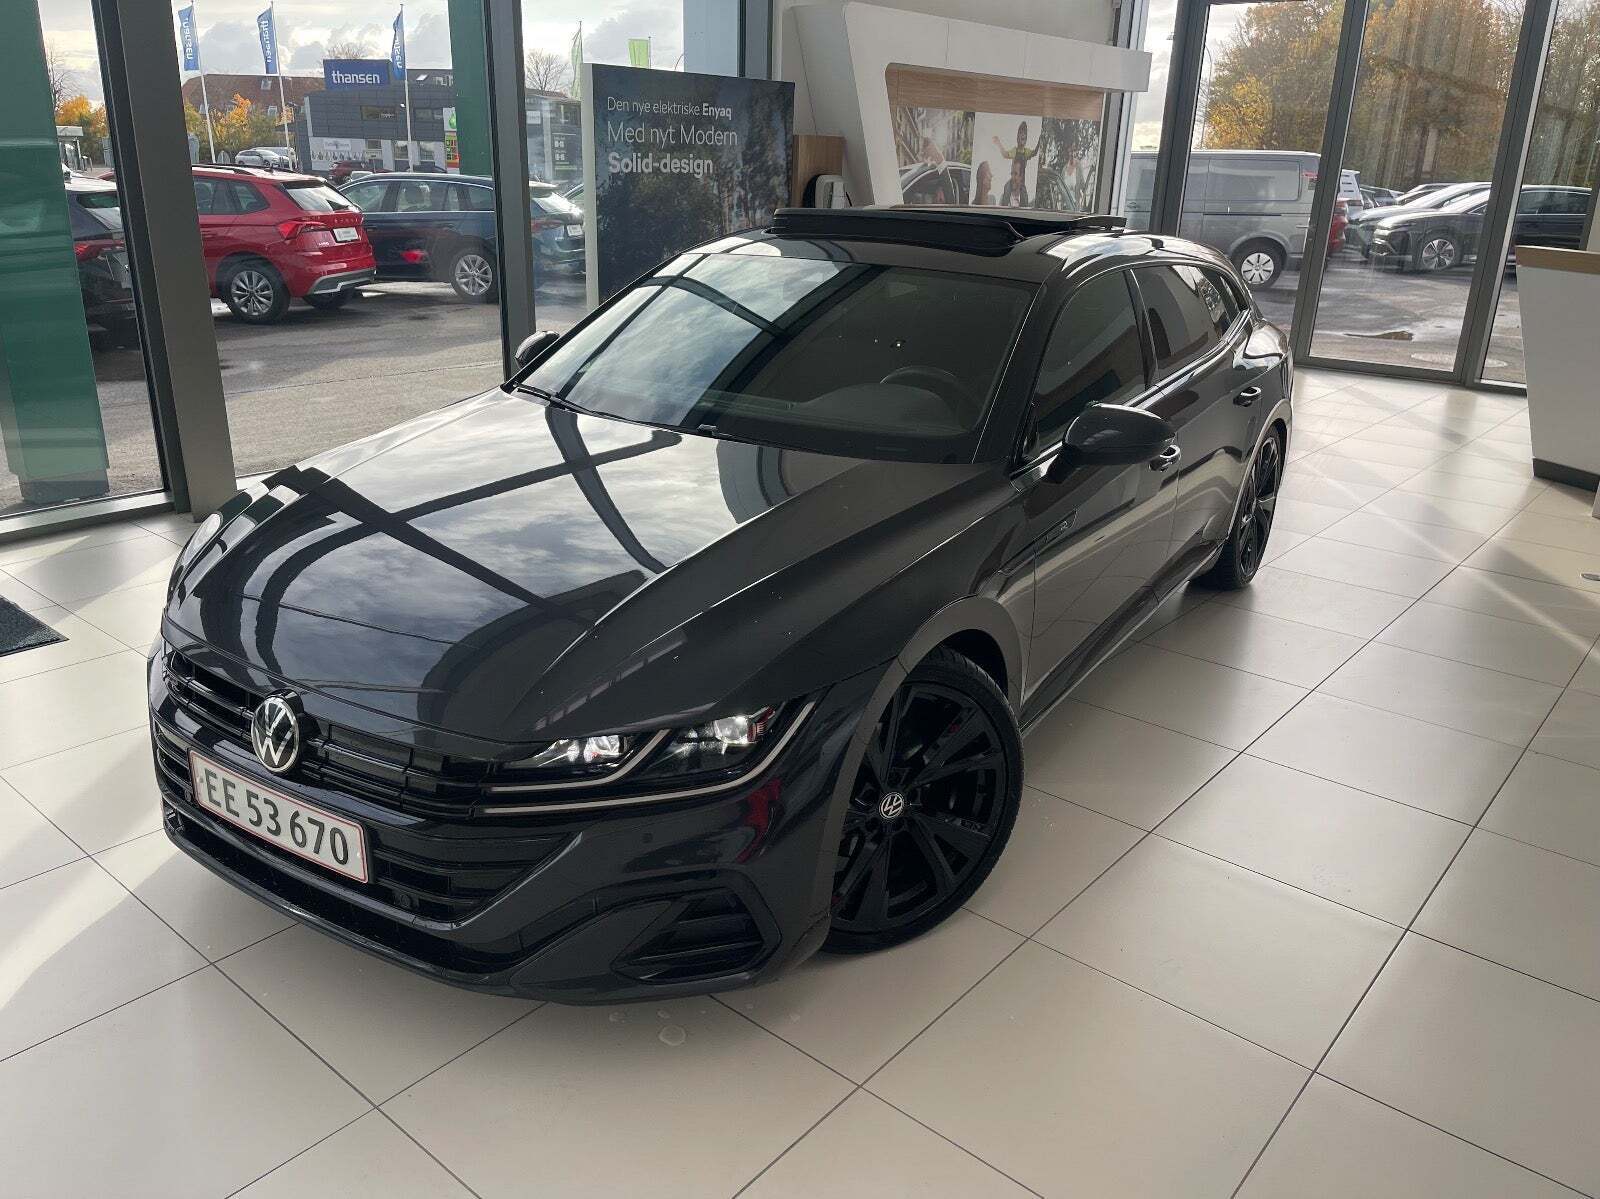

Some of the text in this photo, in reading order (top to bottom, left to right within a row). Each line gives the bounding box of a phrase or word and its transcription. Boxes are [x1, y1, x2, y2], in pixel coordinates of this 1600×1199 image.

[331, 70, 380, 84] thansen
[607, 96, 732, 120] Den nye elektriske Enyaq
[607, 120, 738, 149] Med nyt Modern
[608, 151, 714, 178] Solid-design
[204, 767, 349, 866] EE 53 670
